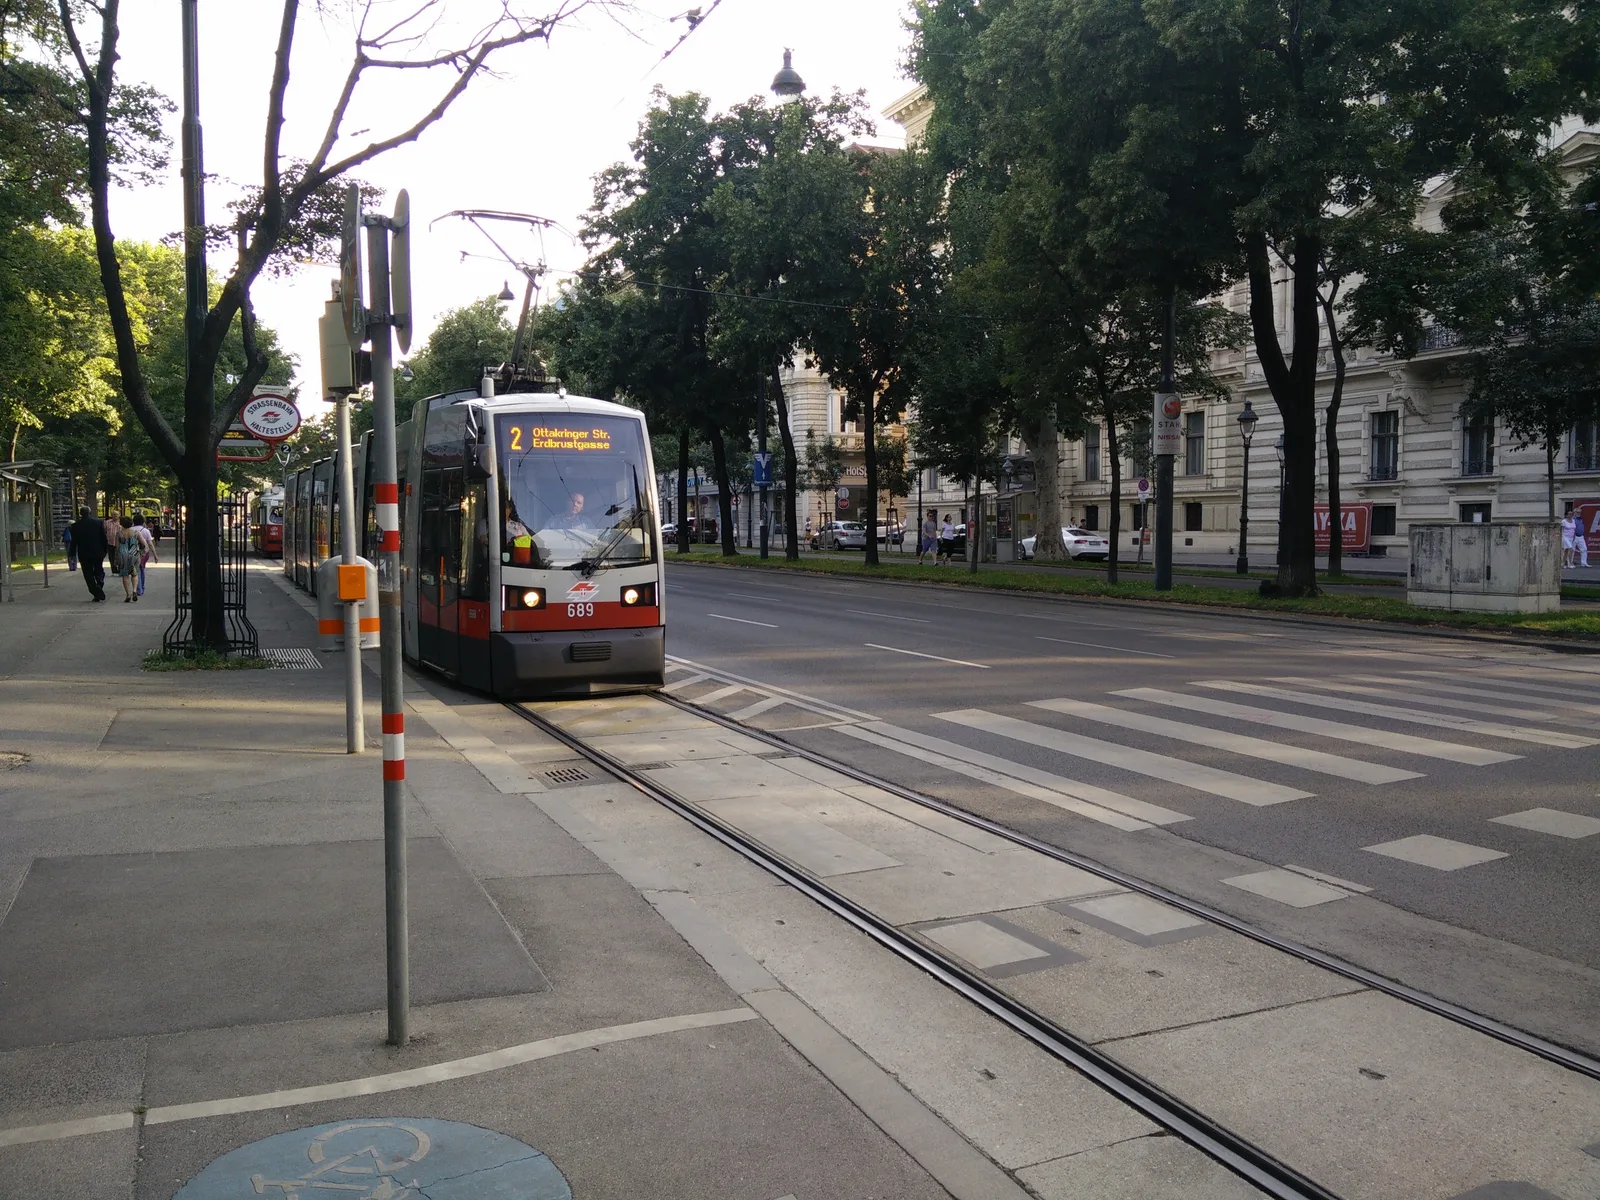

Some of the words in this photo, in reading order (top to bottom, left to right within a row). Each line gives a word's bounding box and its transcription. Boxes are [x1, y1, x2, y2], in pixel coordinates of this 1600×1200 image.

[247, 399, 294, 416] STRASSENBAHN
[249, 421, 293, 435] HALTESTELLE
[532, 427, 589, 440] Ottakringer
[592, 429, 611, 440] Str.
[510, 426, 522, 450] 2
[532, 438, 610, 451] Erdbrustgasse
[283, 445, 290, 453] 2
[567, 603, 594, 618] 689
